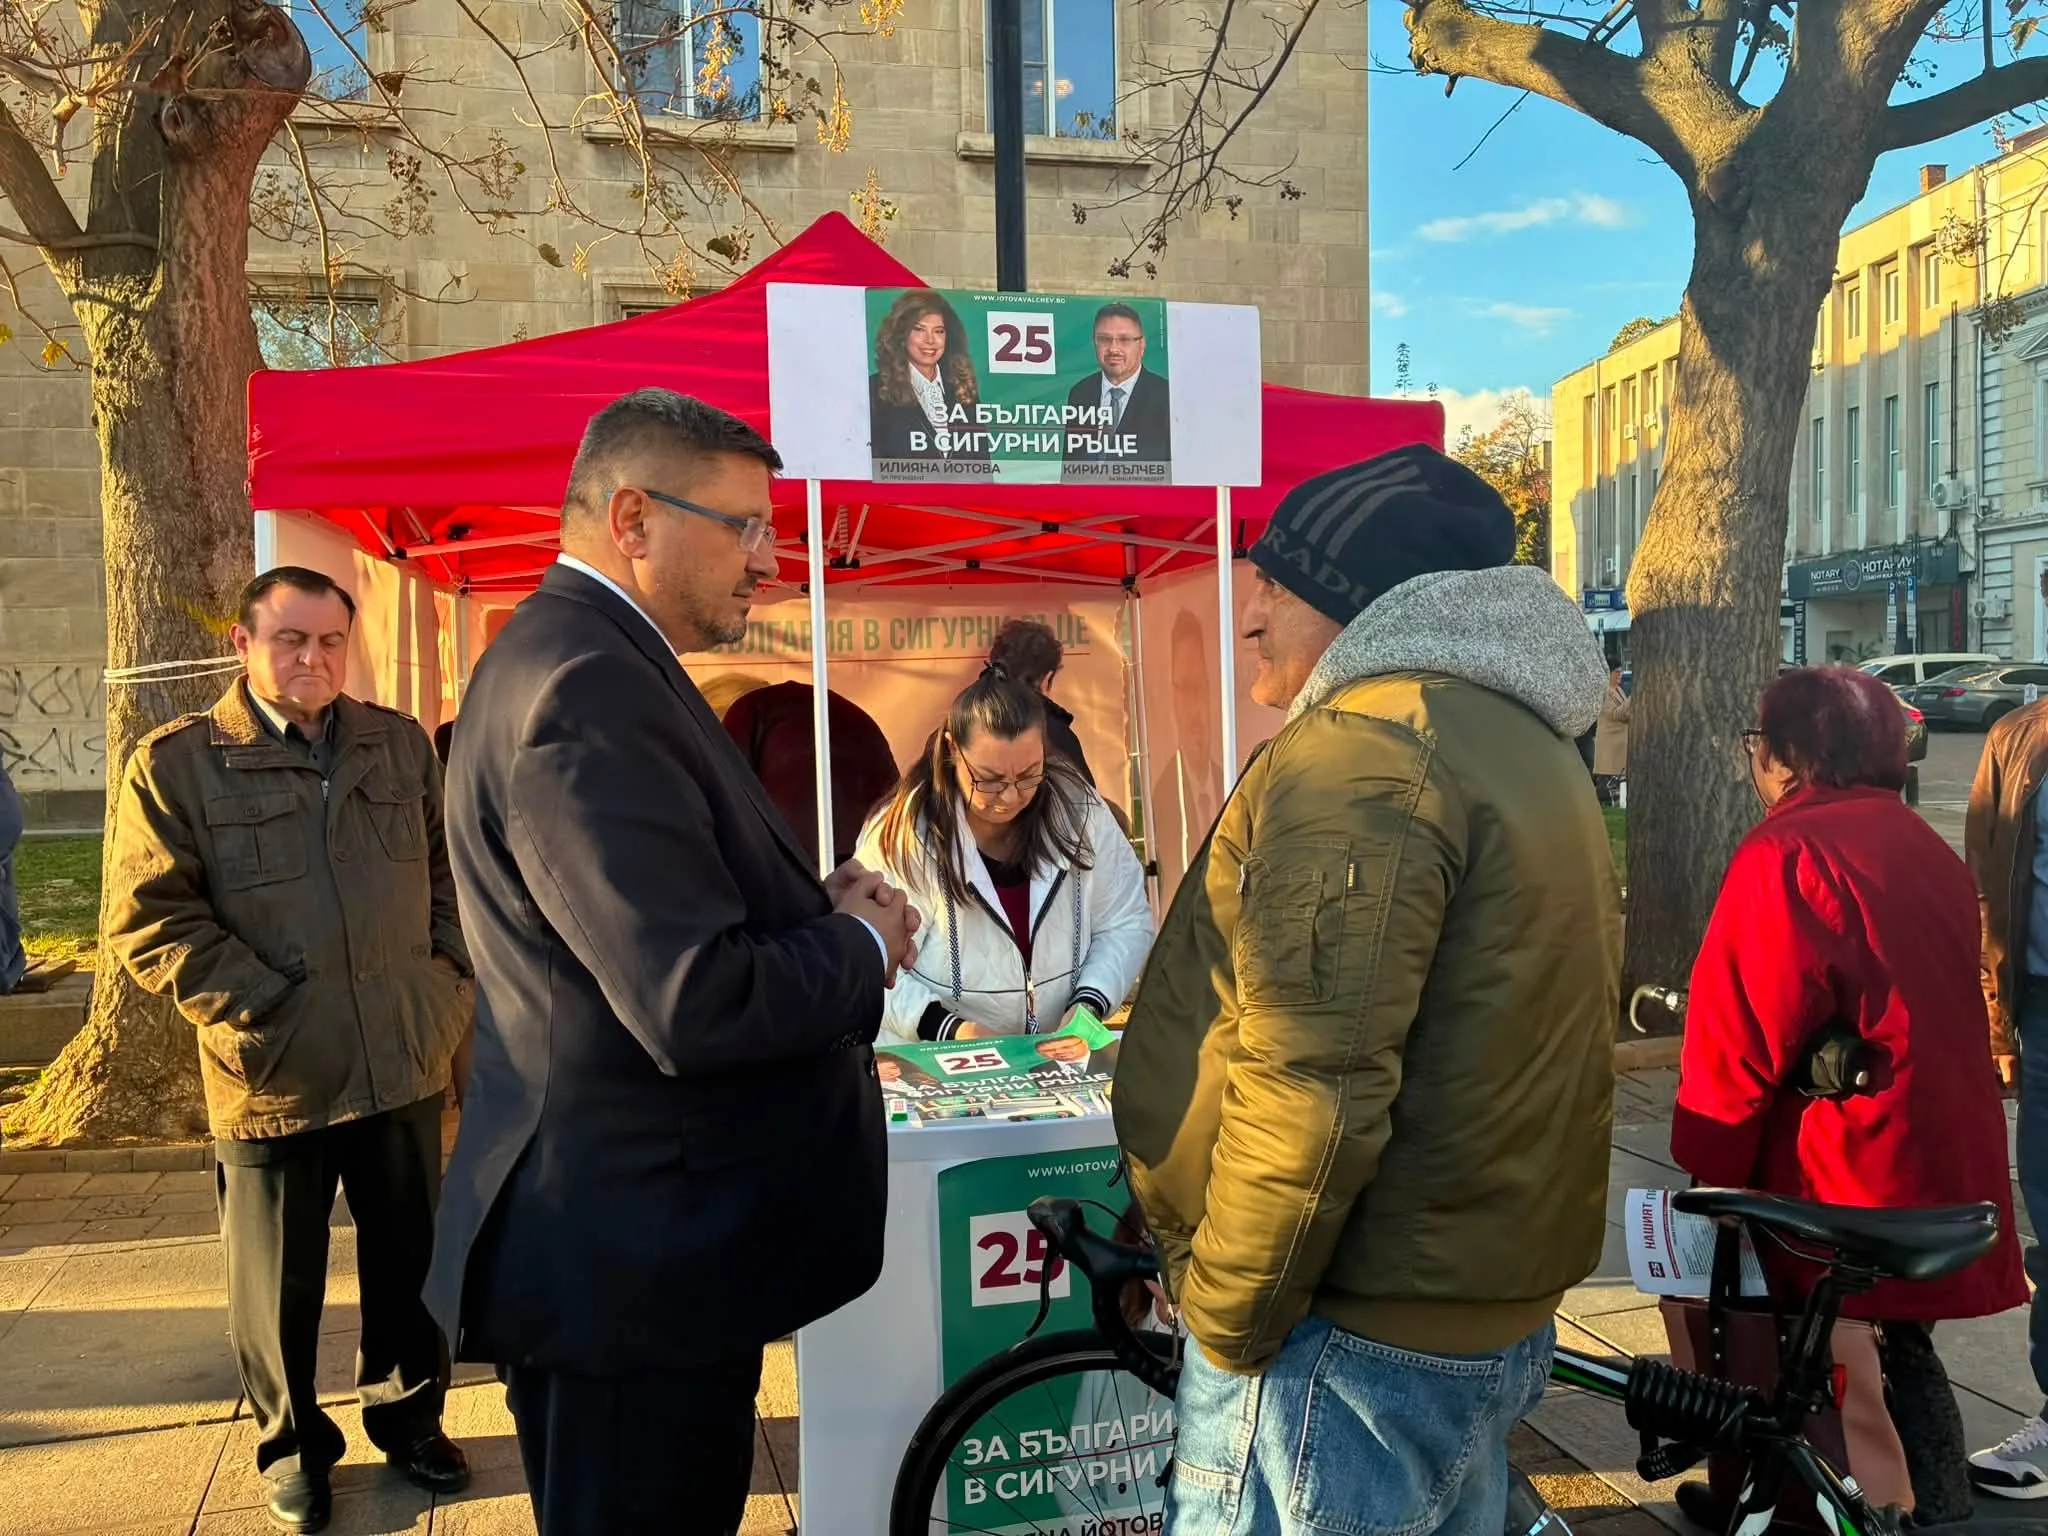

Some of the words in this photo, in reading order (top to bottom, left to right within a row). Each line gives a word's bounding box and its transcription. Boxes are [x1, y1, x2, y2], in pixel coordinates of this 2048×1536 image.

[992, 323, 1053, 363] 25
[931, 402, 969, 424] ЗА
[975, 404, 1113, 426] БЪЛГАРИЯ
[910, 431, 928, 451] В
[934, 431, 1060, 453] СИГУРНИ
[1067, 433, 1138, 457] РЪЦЕ
[879, 461, 940, 474] ИЛИЯНА
[943, 459, 1001, 474] ЙОТОВА
[1063, 464, 1109, 474] КИРИЛ
[1112, 464, 1165, 475] ВЪЛЧЕВ
[1810, 568, 1841, 581] NOTARY
[864, 618, 880, 650] В
[943, 1053, 1003, 1071] 25
[1027, 1158, 1121, 1179] WWW.IOTOVA
[1642, 1203, 1657, 1250] НАШИЯТ
[976, 1229, 1065, 1289] 25
[963, 1435, 1011, 1466] ЗА
[1019, 1408, 1174, 1459] БЪЛГАРИ
[964, 1478, 987, 1505] В
[995, 1451, 1157, 1500] СИГУРНИ
[1081, 1511, 1163, 1536] ЙОТОВ
